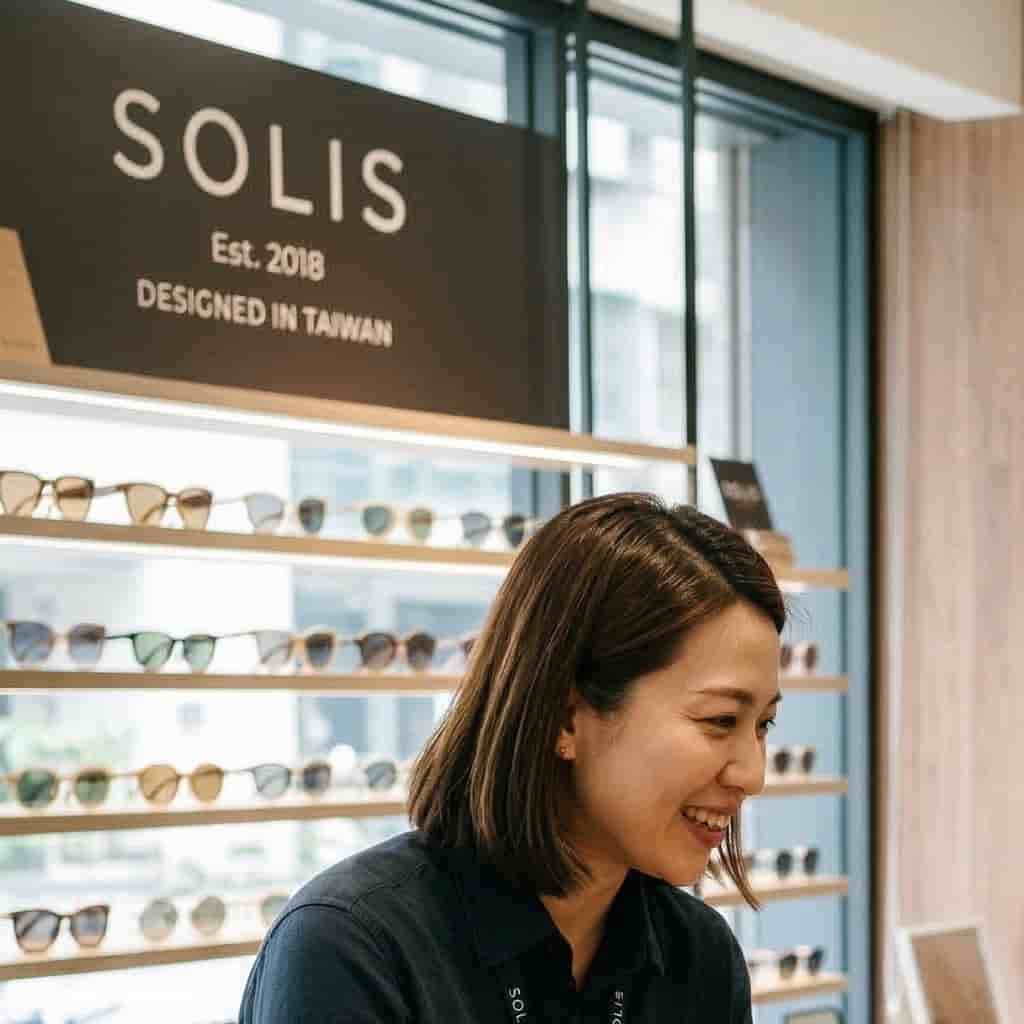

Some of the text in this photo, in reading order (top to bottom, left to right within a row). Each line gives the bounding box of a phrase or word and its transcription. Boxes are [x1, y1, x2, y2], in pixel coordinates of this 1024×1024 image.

[113, 88, 406, 234] SOLIS
[211, 231, 325, 281] Est. 2018
[137, 278, 393, 348] DESIGNED IN TAIWAN
